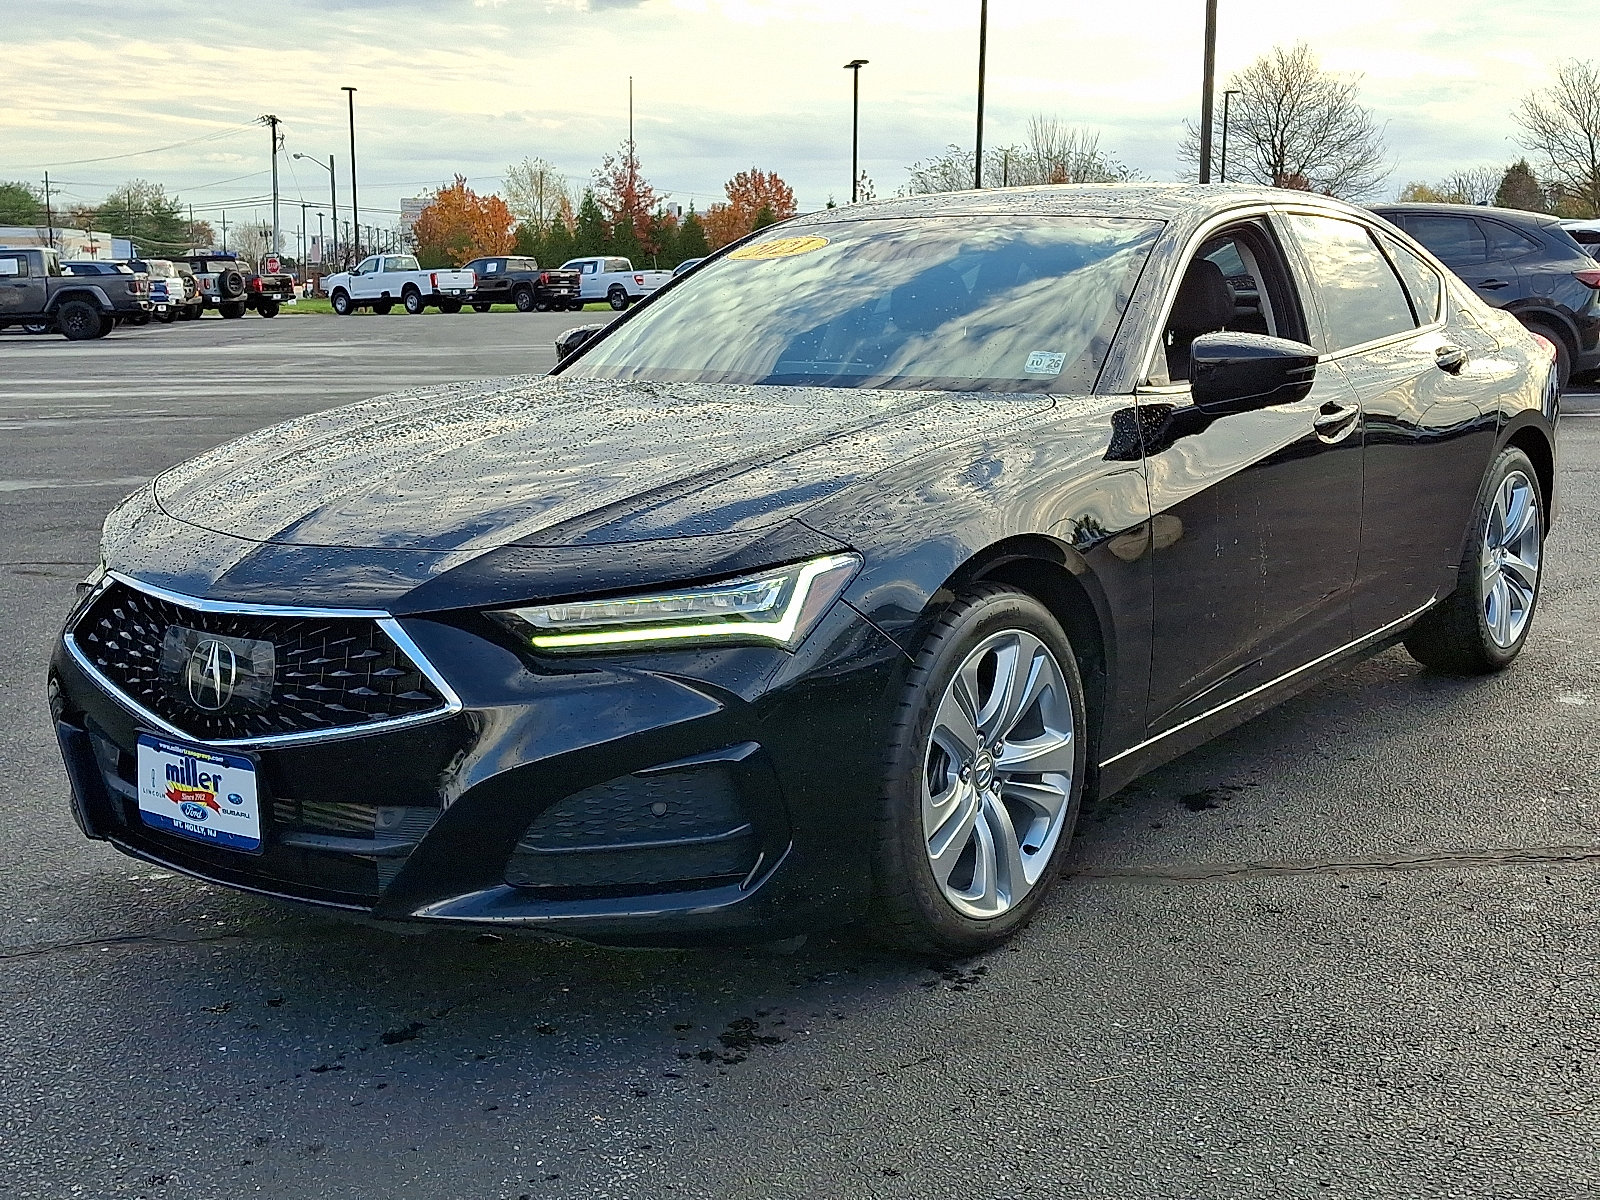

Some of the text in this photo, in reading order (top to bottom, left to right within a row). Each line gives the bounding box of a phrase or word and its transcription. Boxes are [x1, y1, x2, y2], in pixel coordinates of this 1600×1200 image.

[1030, 358, 1062, 368] 10 26
[165, 757, 222, 793] miller
[143, 787, 166, 799] LINCOLN
[184, 804, 204, 819] Ford
[222, 808, 250, 819] SUBARU
[184, 822, 206, 836] HOLLY,
[207, 828, 217, 837] NJ
